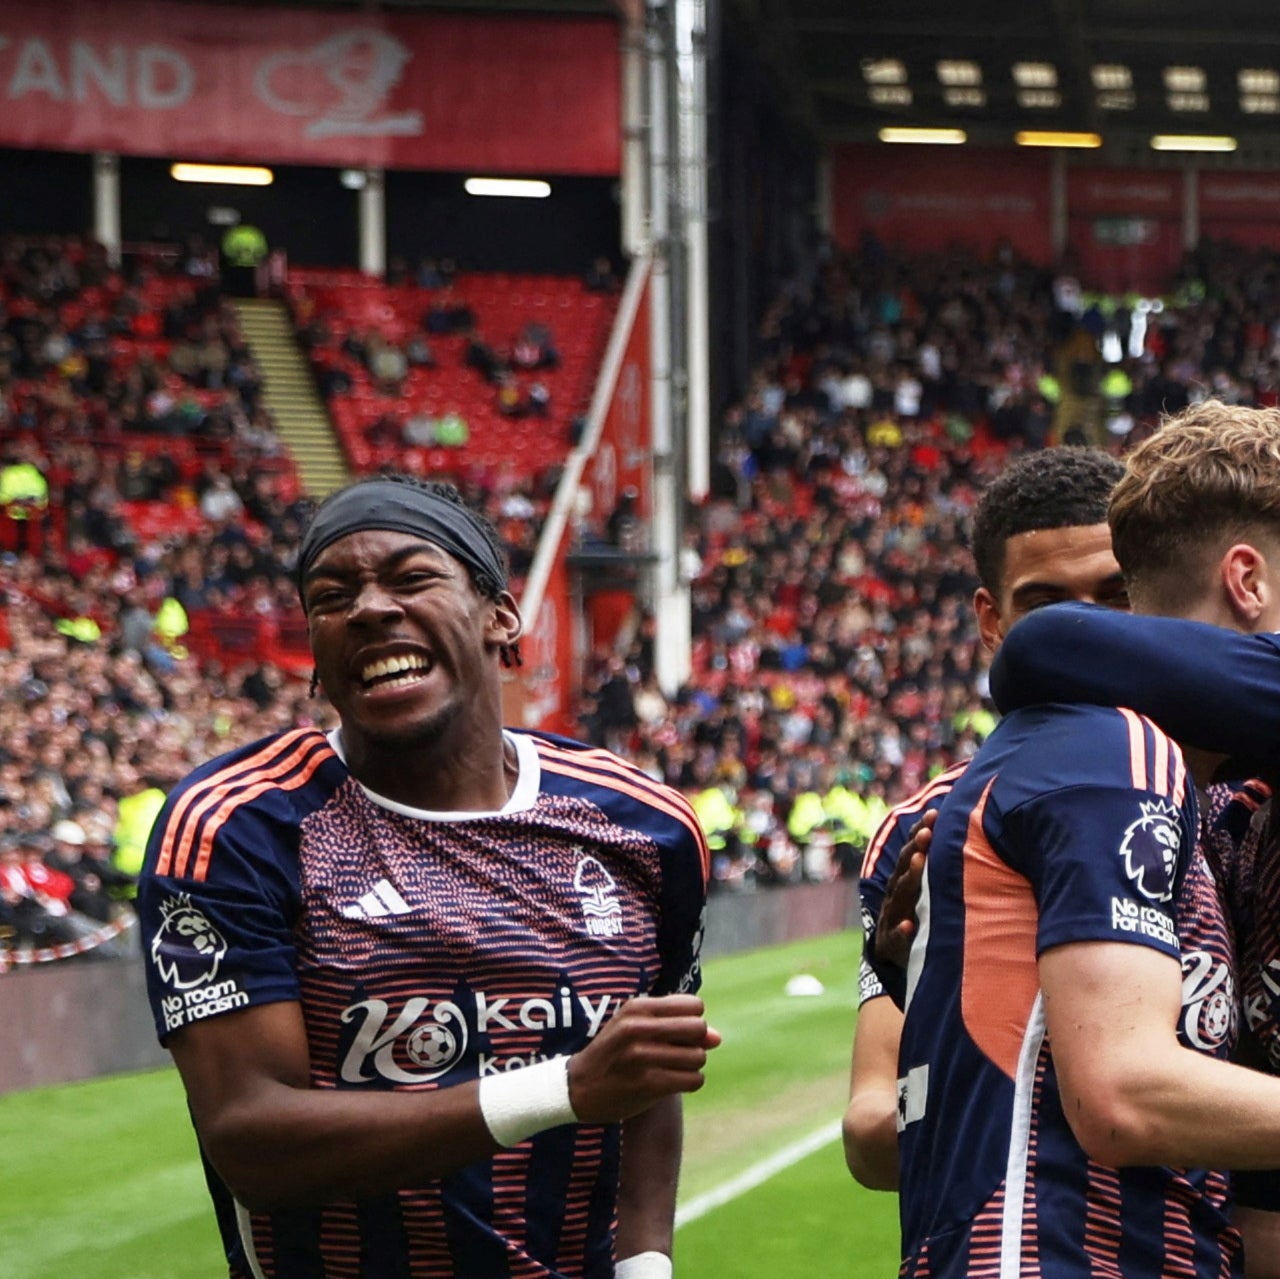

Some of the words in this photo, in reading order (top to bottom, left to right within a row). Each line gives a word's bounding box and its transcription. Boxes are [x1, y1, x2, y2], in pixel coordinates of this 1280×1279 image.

[0, 36, 197, 109] AND
[1112, 897, 1139, 917] No
[161, 996, 183, 1014] No
[184, 980, 237, 1006] room
[186, 991, 249, 1022] racism
